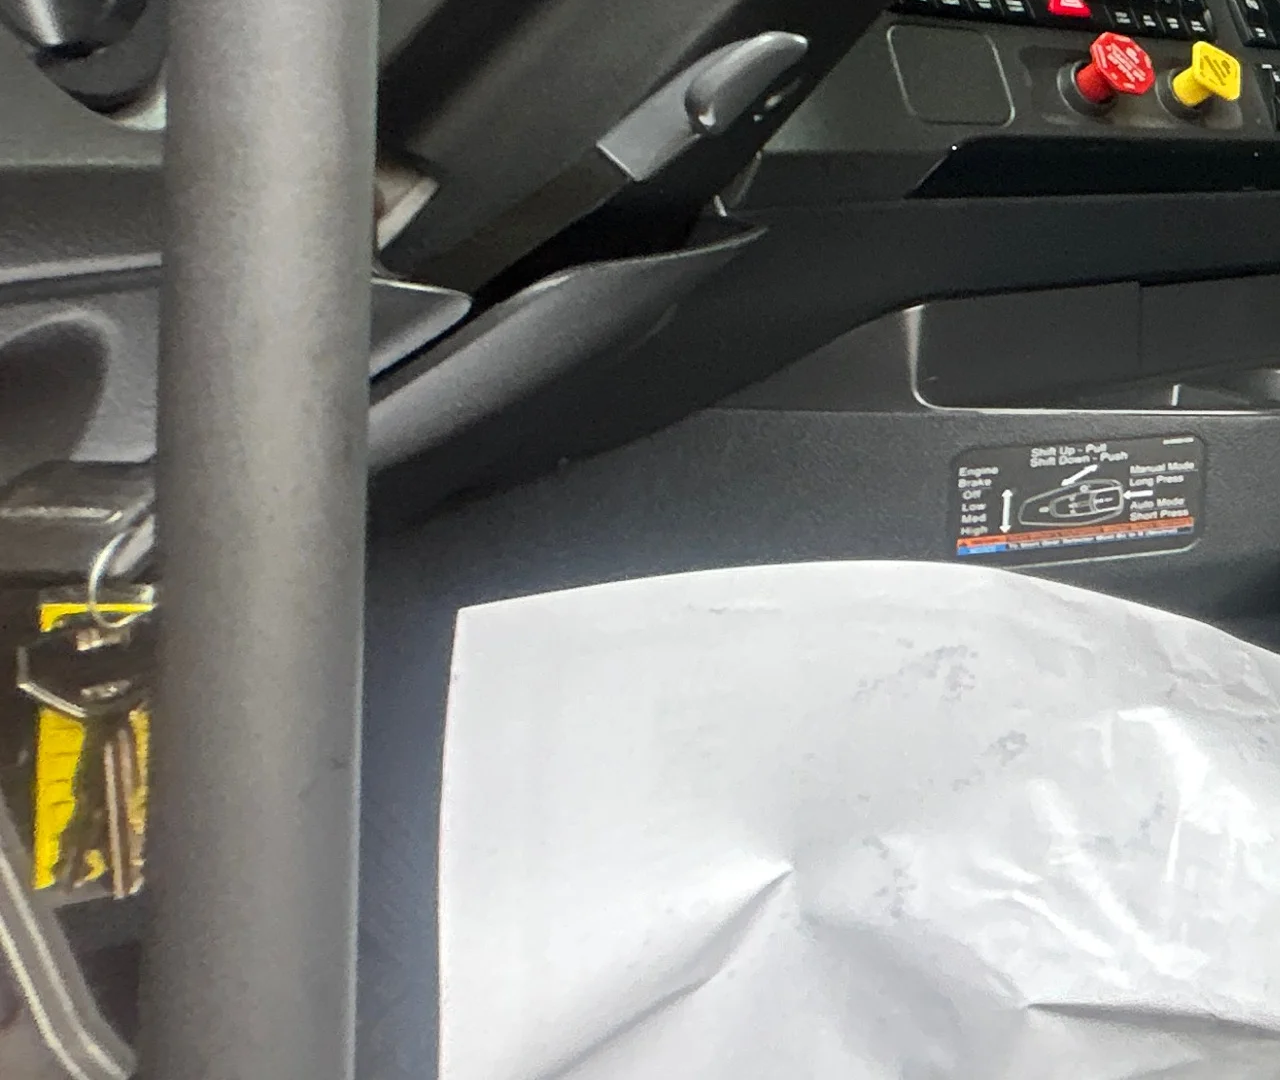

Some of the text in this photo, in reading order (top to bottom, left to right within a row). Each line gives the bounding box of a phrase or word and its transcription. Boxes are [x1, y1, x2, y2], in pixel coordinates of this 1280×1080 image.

[1031, 447, 1056, 458] Shift
[1059, 446, 1076, 456] Up
[1085, 443, 1107, 453] Pull
[1030, 457, 1056, 468] Shift
[1059, 455, 1090, 466] Down
[1100, 451, 1128, 462] Push
[959, 467, 999, 477] Engine
[1130, 461, 1194, 474] Manual Mode
[958, 478, 992, 488] Brake
[1129, 475, 1184, 487] Long Press
[962, 490, 981, 499] Off
[962, 503, 986, 512] Low
[1130, 498, 1184, 510] Auto Mode
[961, 514, 987, 523] Med
[1130, 509, 1189, 521] Short Press
[960, 526, 988, 536] High
